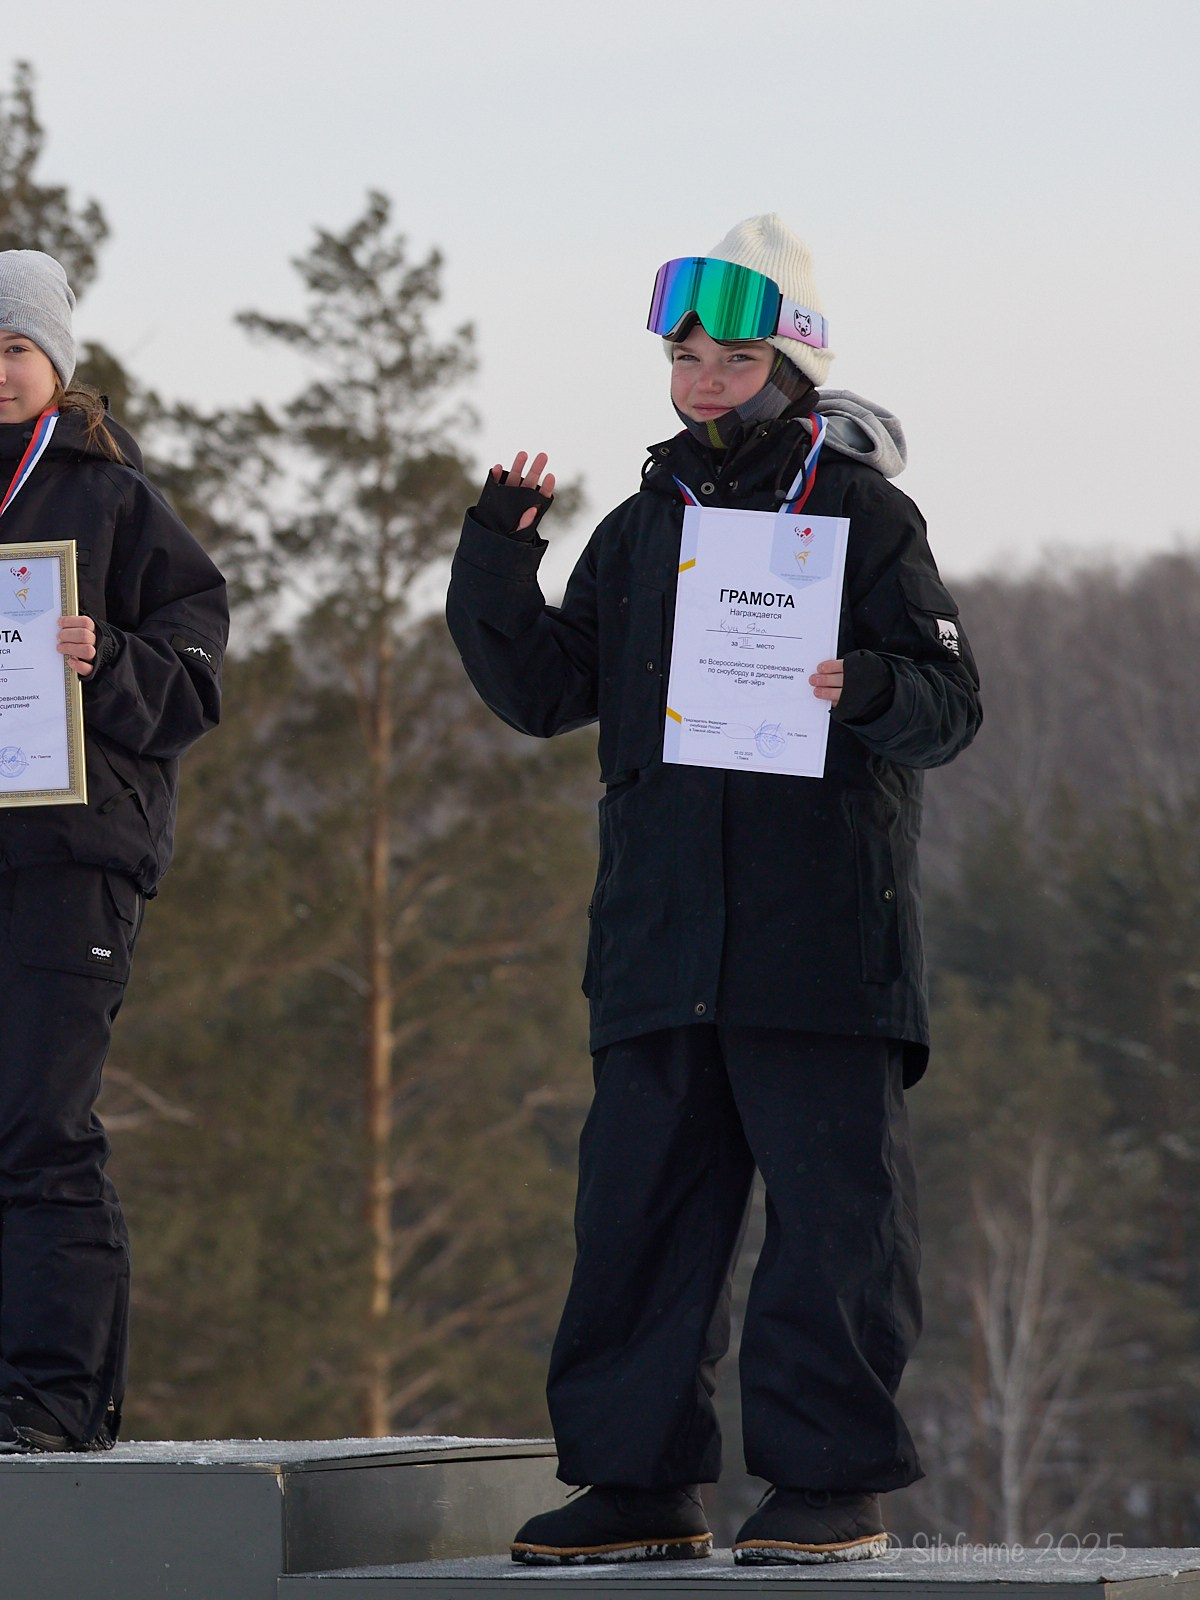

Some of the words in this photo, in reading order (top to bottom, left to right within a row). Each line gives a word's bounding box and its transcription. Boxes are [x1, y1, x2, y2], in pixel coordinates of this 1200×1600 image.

[720, 588, 795, 608] ГРАМОТА
[730, 608, 782, 620] Награждается
[708, 658, 755, 669] Всероссийских
[756, 664, 804, 673] соревнованиях
[716, 668, 749, 678] сноуборду
[755, 672, 794, 680] дисциплине
